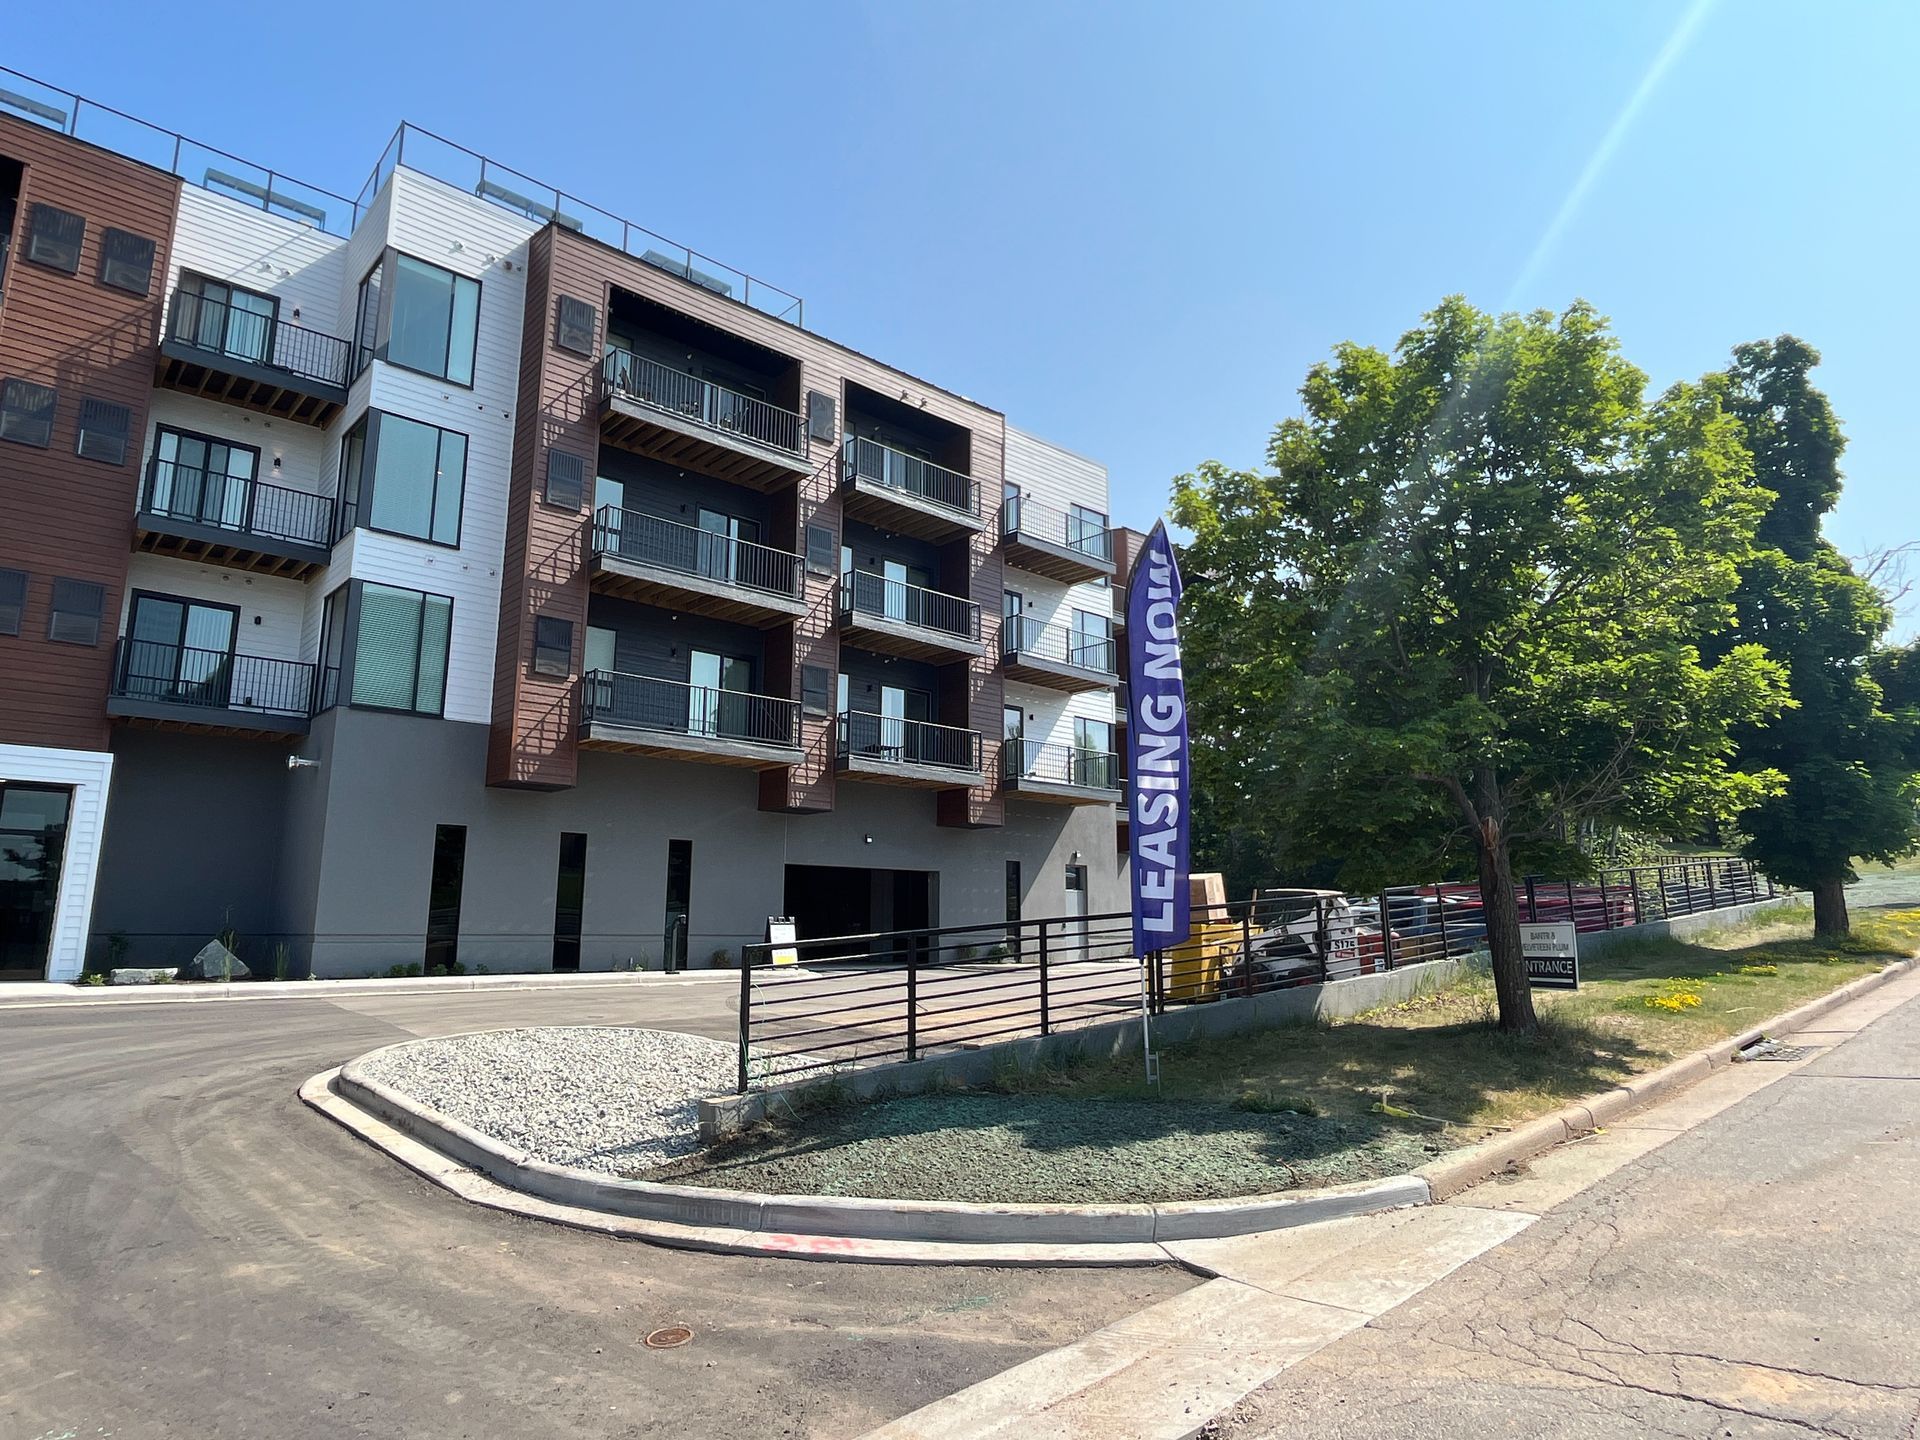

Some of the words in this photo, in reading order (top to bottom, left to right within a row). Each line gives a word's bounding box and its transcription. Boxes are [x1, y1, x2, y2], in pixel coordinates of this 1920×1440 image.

[1144, 550, 1182, 680] NOW
[1137, 694, 1182, 932] LEASING
[1525, 960, 1574, 974] NTRANCE
[1552, 943, 1569, 951] PLUM
